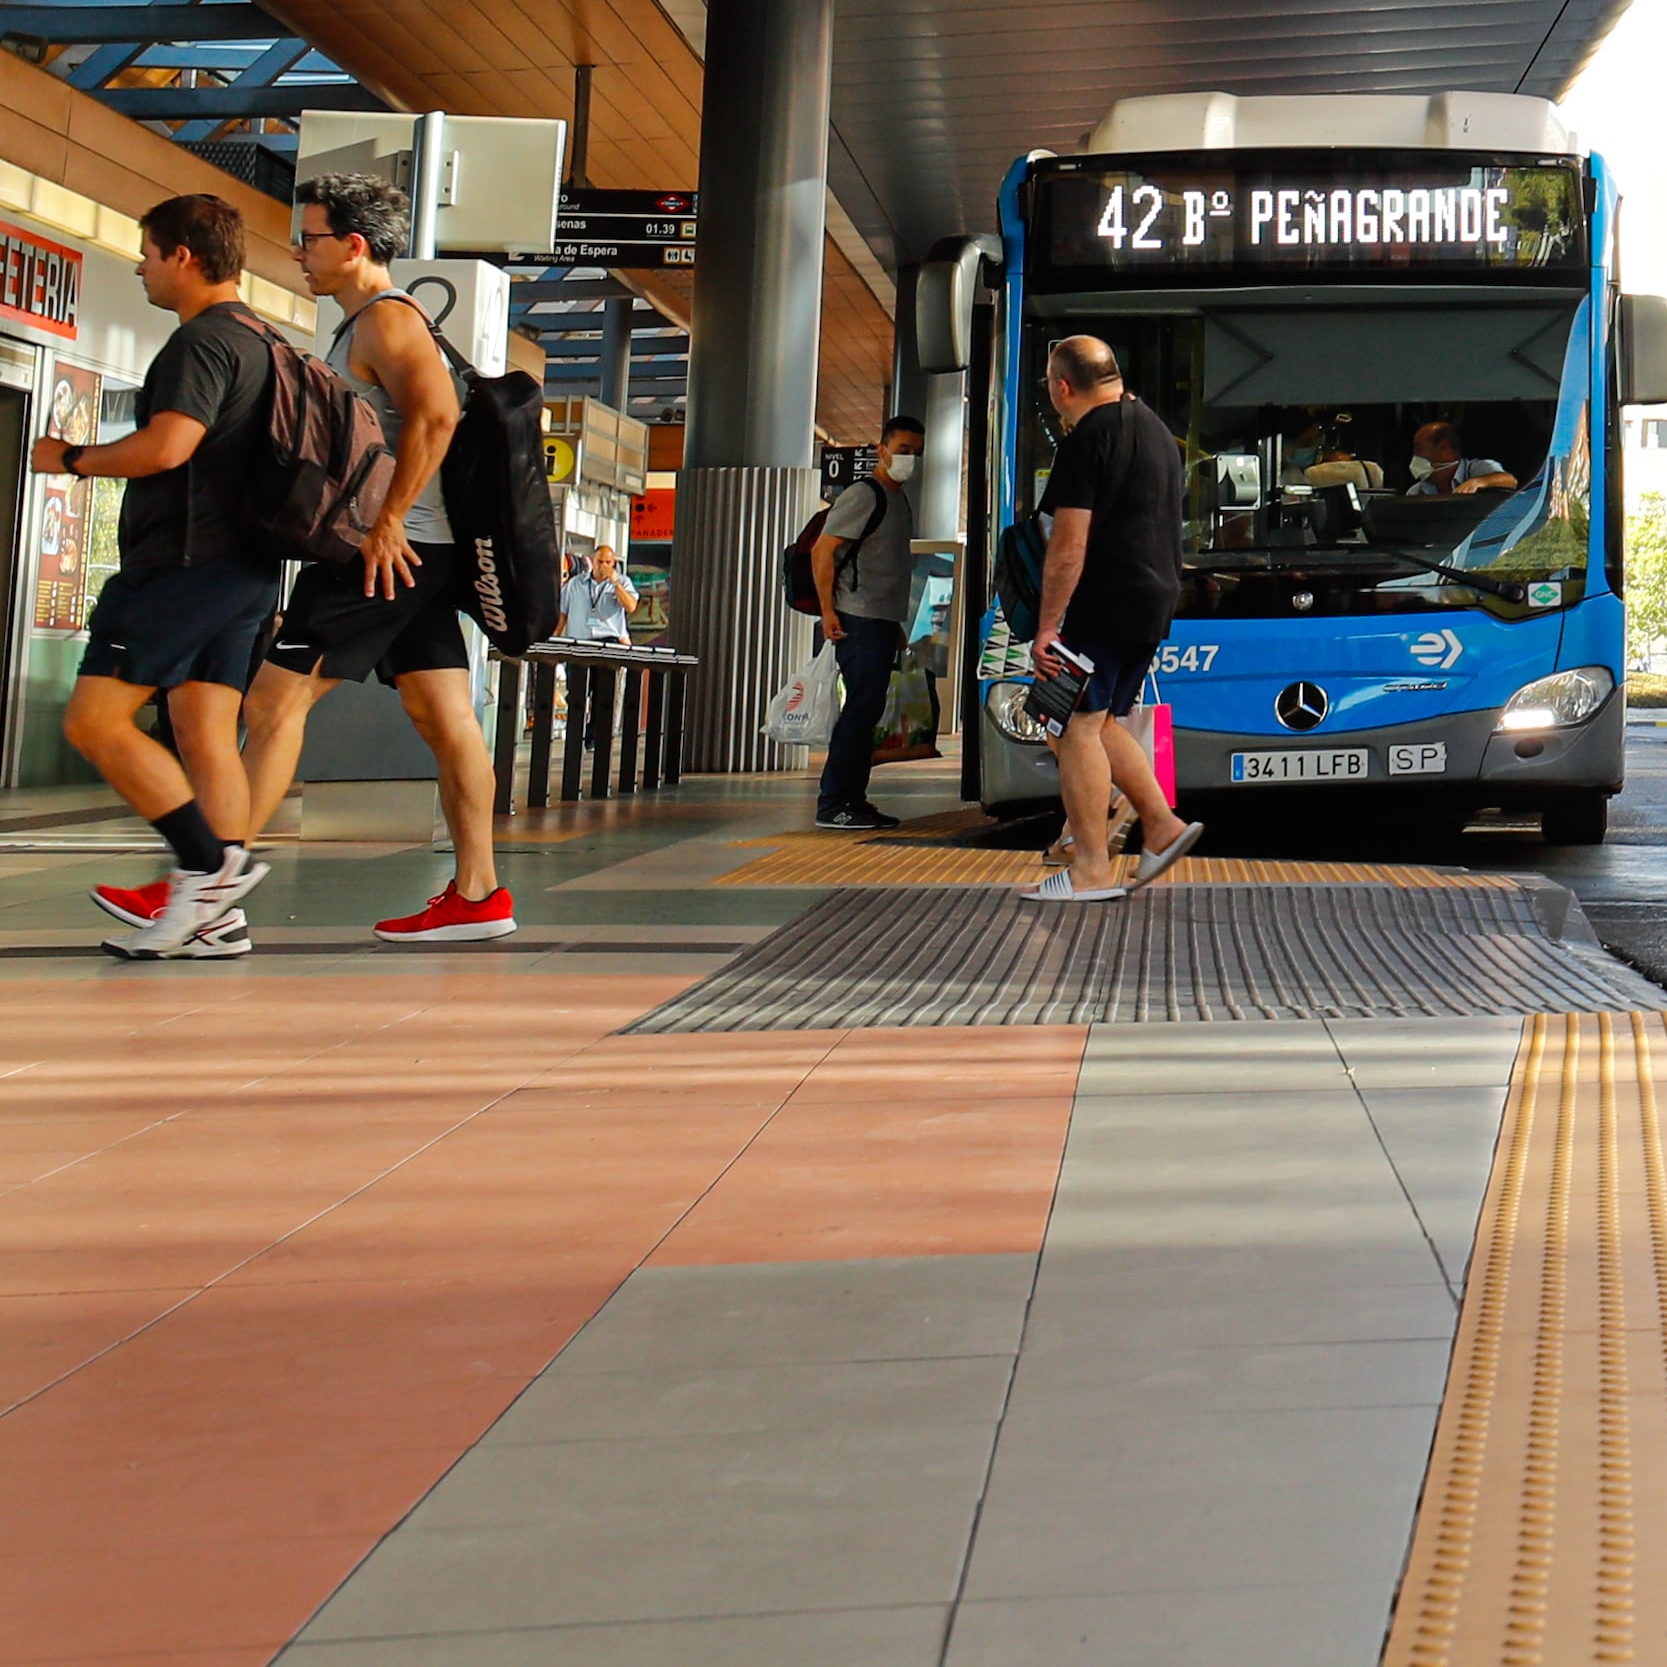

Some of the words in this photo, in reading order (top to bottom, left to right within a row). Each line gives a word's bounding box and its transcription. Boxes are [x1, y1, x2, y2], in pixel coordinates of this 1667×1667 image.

[1098, 185, 1163, 249] 42
[1251, 188, 1508, 244] PEÑAGRANDE
[646, 223, 675, 235] 01.39
[564, 244, 577, 255] de
[580, 244, 618, 257] Espera
[828, 460, 839, 478] 0
[472, 536, 507, 633] Wilson
[1248, 752, 1305, 777] 3411
[1316, 752, 1361, 776] LFB
